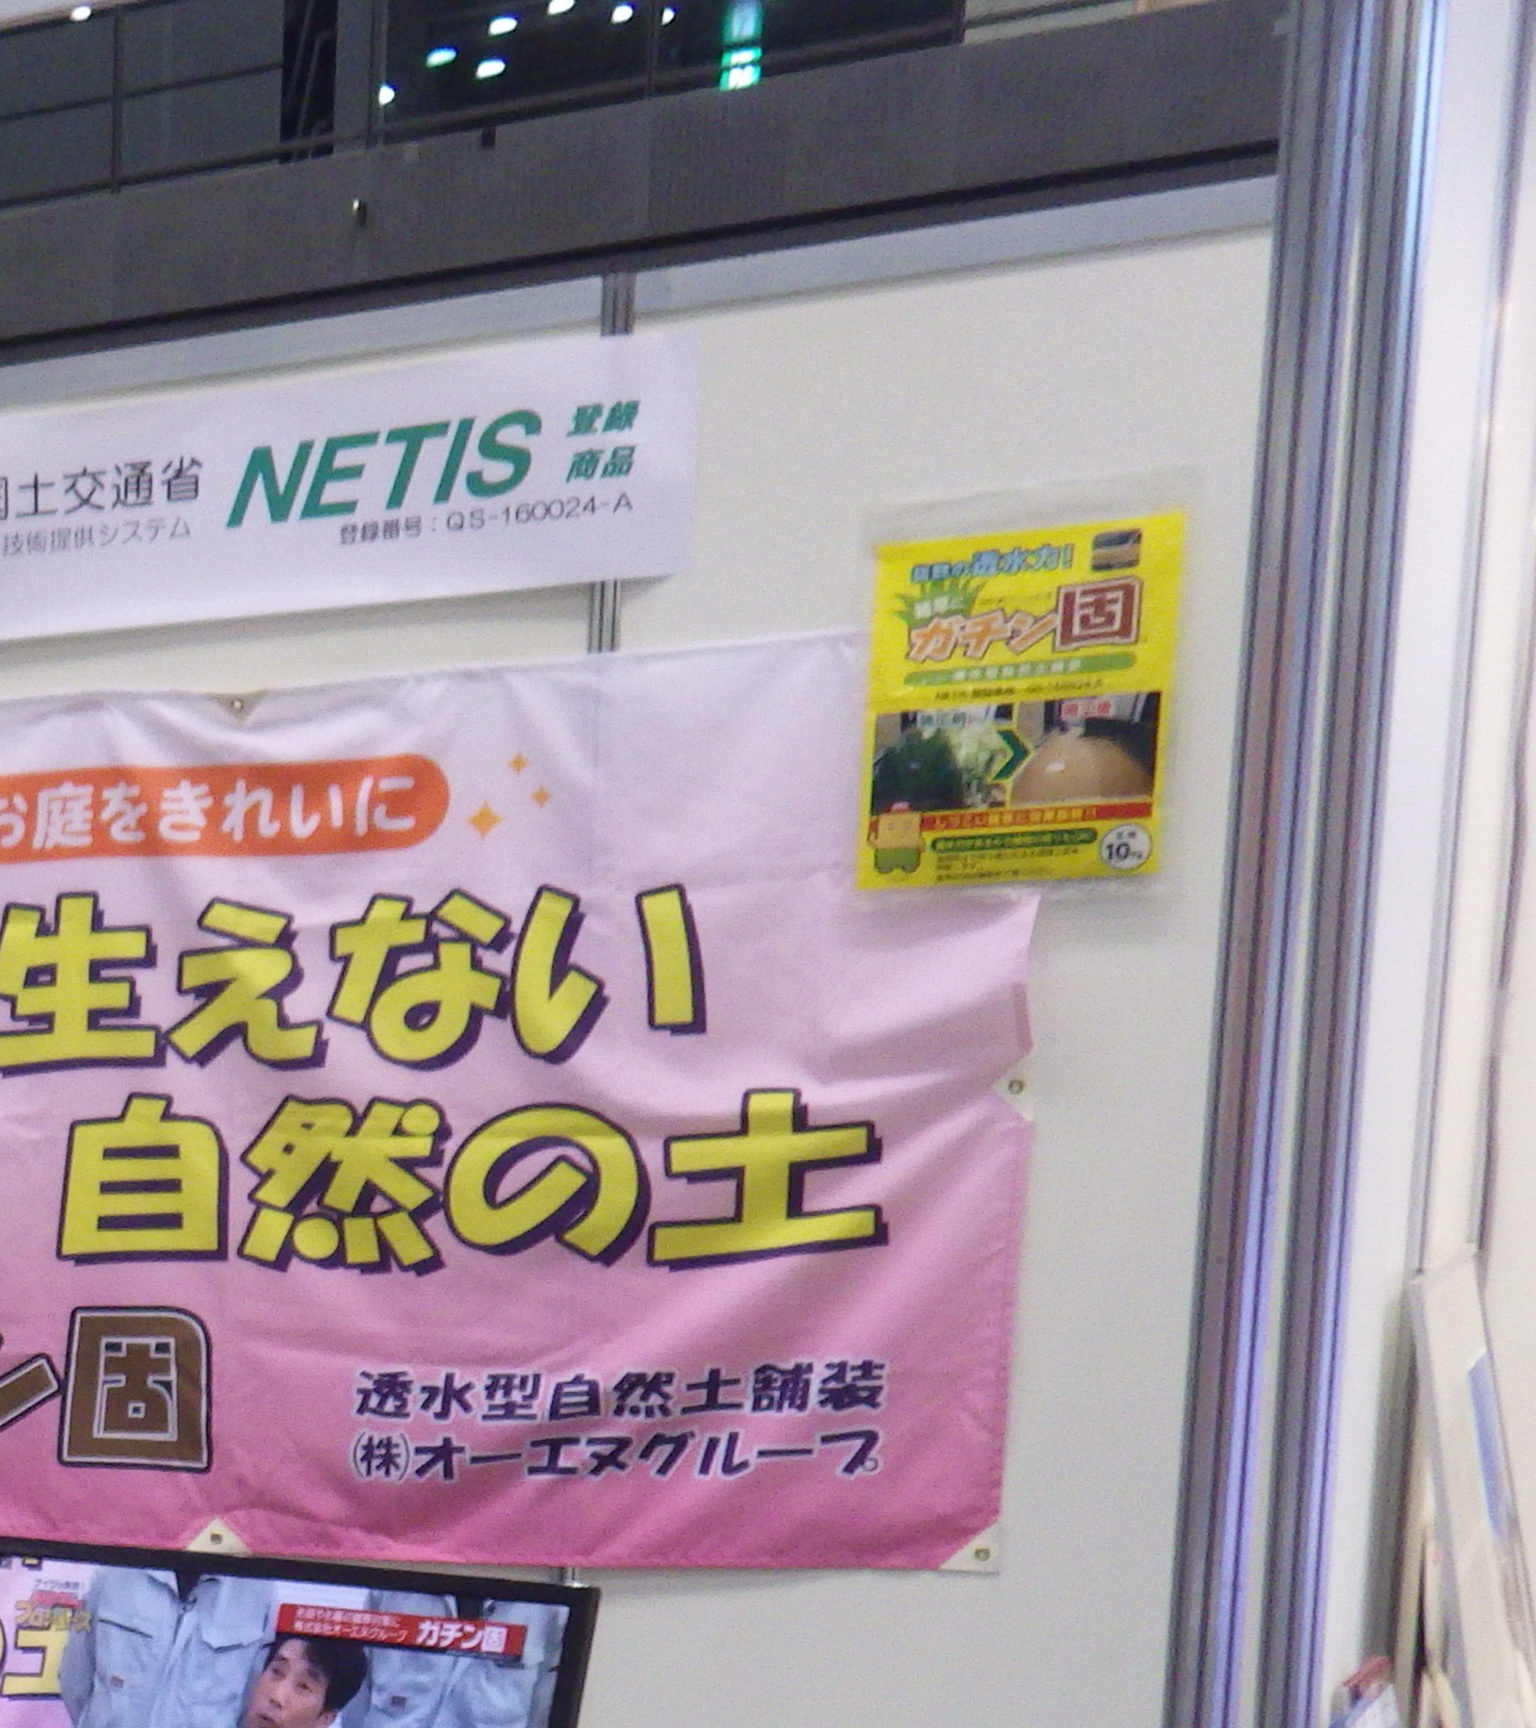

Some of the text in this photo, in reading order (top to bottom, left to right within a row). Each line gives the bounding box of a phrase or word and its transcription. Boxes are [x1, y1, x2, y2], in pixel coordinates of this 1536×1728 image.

[225, 408, 543, 530] NETIS
[565, 445, 637, 484] 商品
[904, 575, 1144, 664] ガチン固
[56, 1083, 890, 1276] 自然の土
[354, 1359, 888, 1423] 透水型自然土舗装
